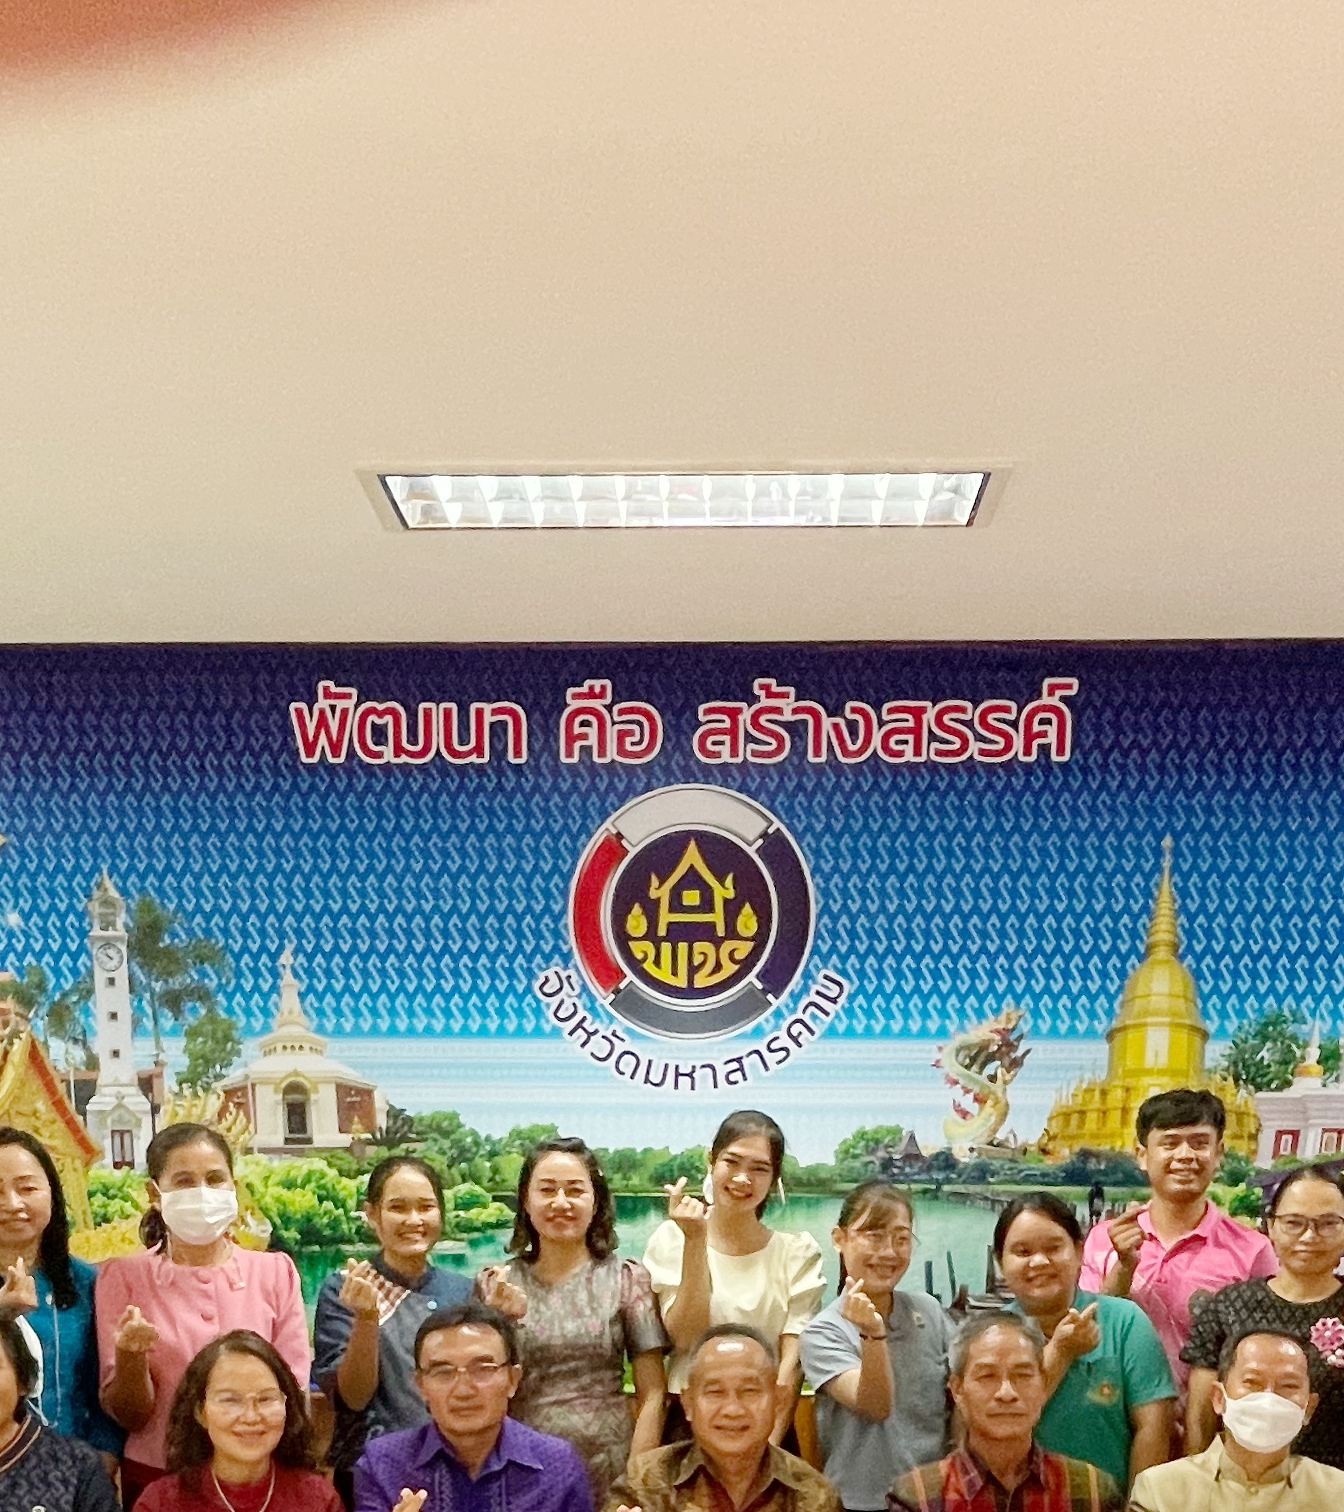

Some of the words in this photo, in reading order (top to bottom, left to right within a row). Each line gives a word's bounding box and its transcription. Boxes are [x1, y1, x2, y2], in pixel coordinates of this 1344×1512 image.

[291, 680, 528, 766] พัฒนา
[558, 679, 664, 765] คือ
[693, 677, 1079, 766] สร้างสรรค์
[538, 967, 849, 1091] จังหวัดมหาสารคาม
